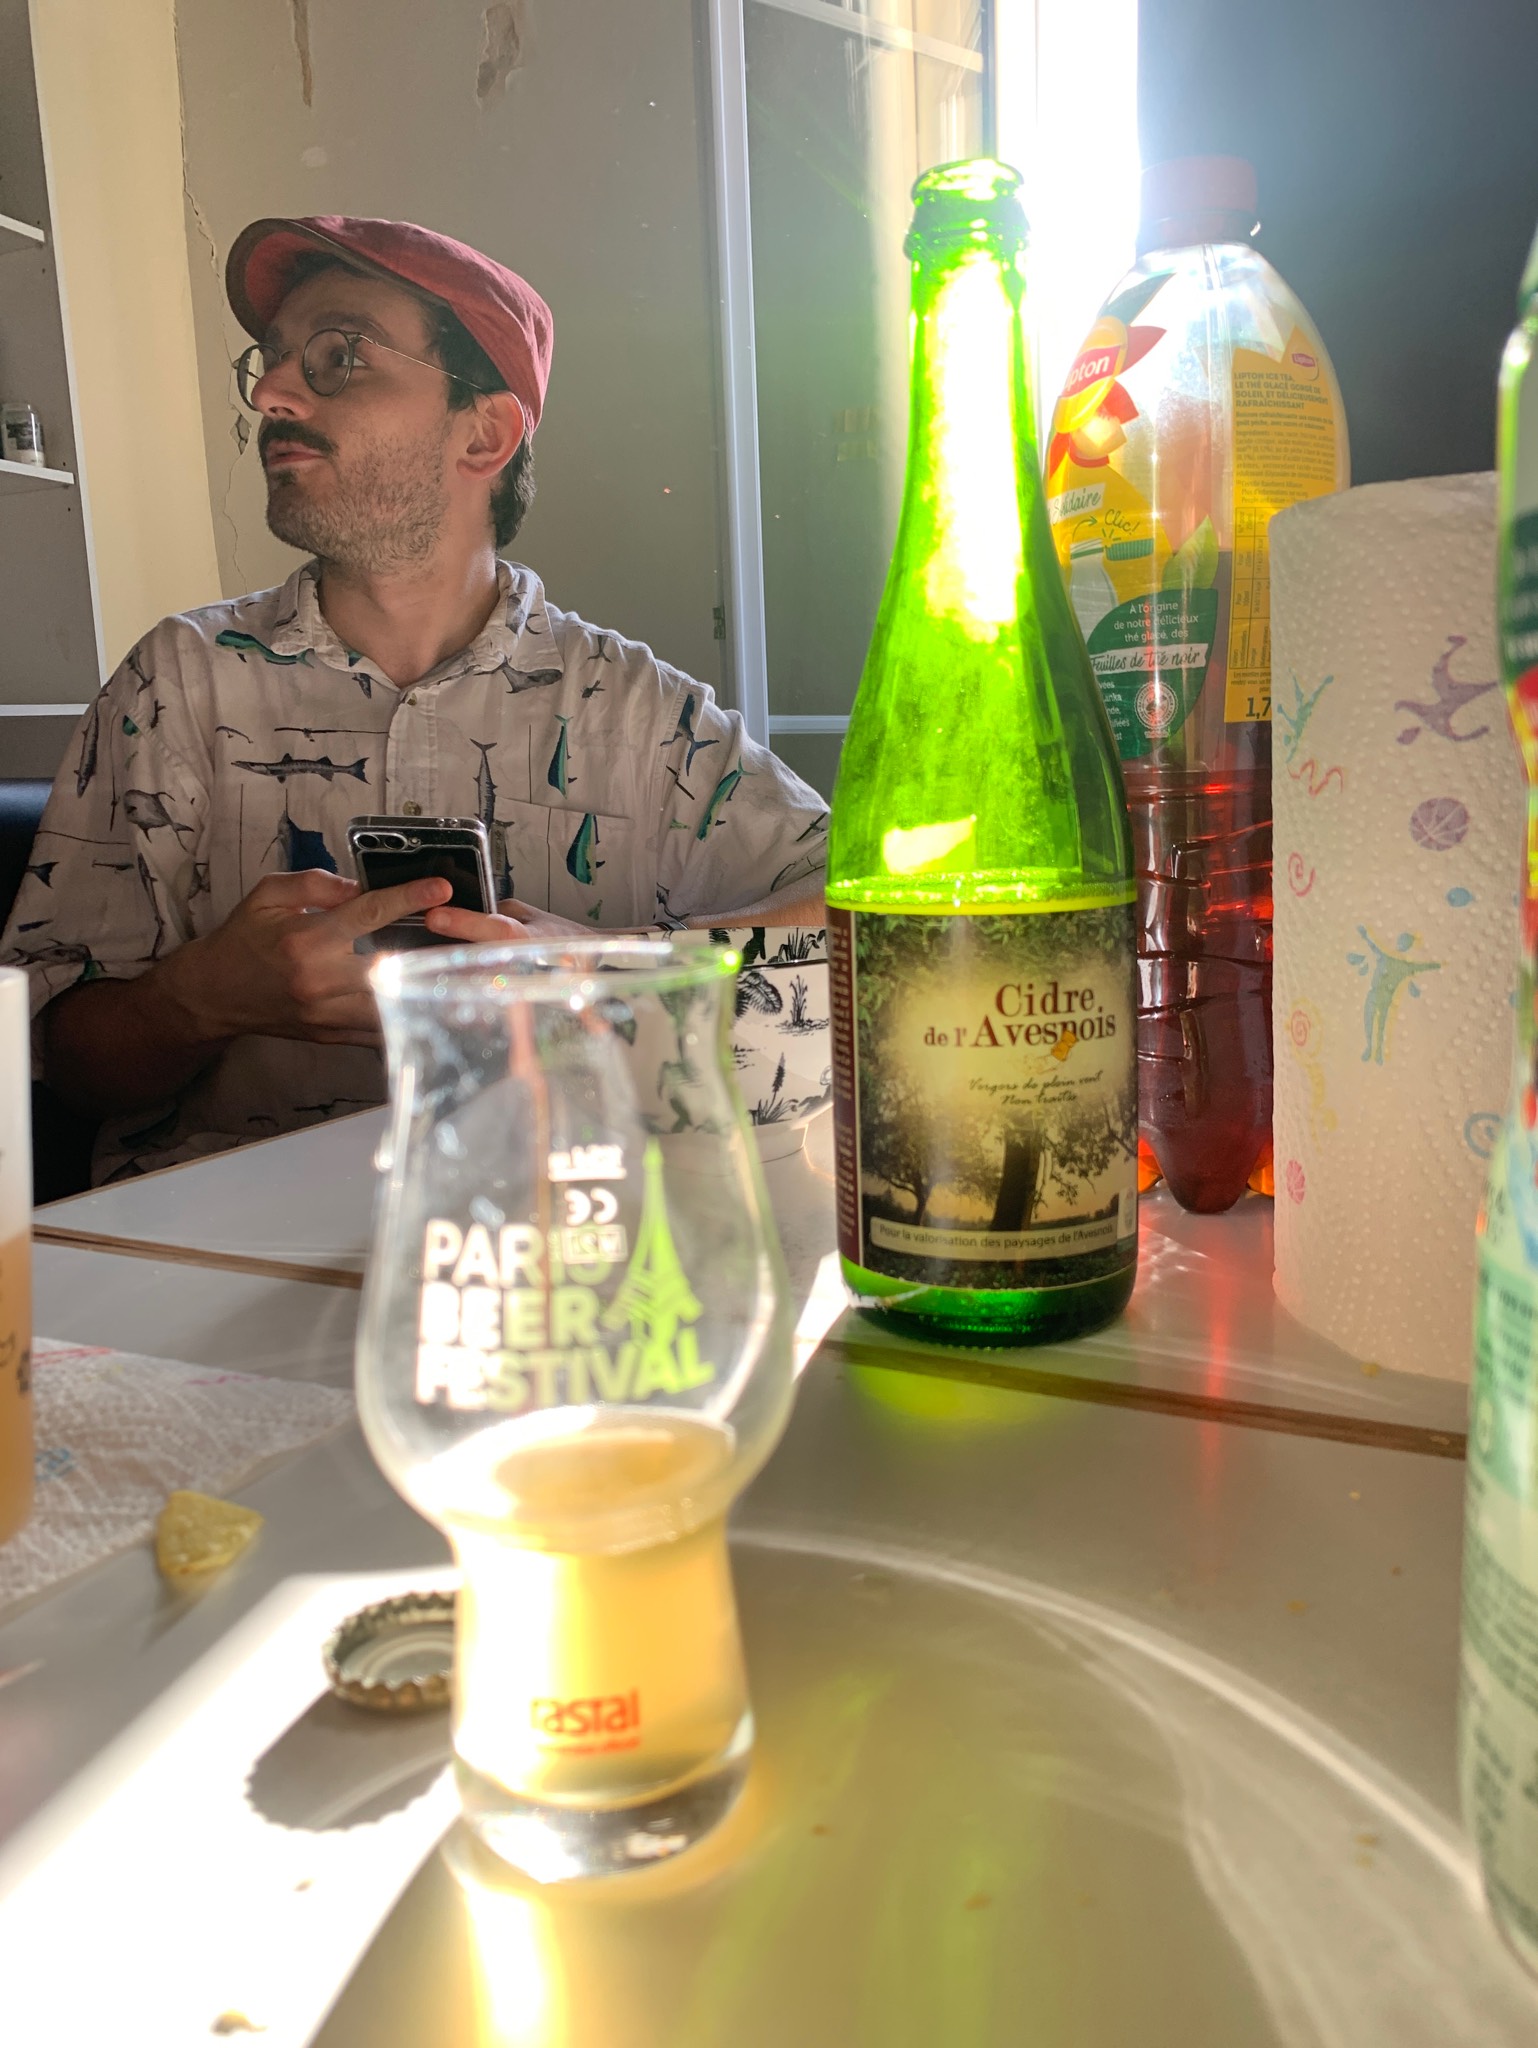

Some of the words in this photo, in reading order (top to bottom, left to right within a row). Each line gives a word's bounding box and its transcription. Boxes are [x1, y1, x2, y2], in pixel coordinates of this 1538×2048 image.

[1234, 372, 1264, 380] LIPTON
[1266, 372, 1279, 380] ICE
[1246, 381, 1261, 389] THÉ
[1263, 381, 1288, 390] GLACÉ
[1236, 399, 1304, 409] RAFRAÎCHISSANT
[1105, 509, 1140, 535] Clic!
[1130, 602, 1137, 614] À
[1114, 621, 1124, 630] de
[1127, 619, 1151, 629] notre
[1154, 614, 1199, 626] délicieux
[1125, 632, 1139, 642] thé
[1171, 629, 1189, 639] des
[1092, 654, 1126, 671] Feuilles
[1130, 652, 1144, 667] de
[1172, 647, 1200, 665] noir
[995, 981, 1094, 1018] Cidre
[924, 1027, 948, 1046] de
[954, 1006, 1116, 1047] l'Avesnois
[1023, 1078, 1037, 1090] de
[1041, 1075, 1075, 1095] plain
[1079, 1070, 1103, 1085] vent
[1001, 1095, 1032, 1104] Non
[879, 1224, 900, 1239] Pour
[902, 1228, 911, 1240] la
[913, 1232, 977, 1247] valorisation
[981, 1235, 1000, 1247] des
[1004, 1234, 1055, 1249] paysages
[1058, 1233, 1071, 1243] de
[419, 1283, 601, 1350] BEER
[415, 1320, 717, 1413] FESTIVAL
